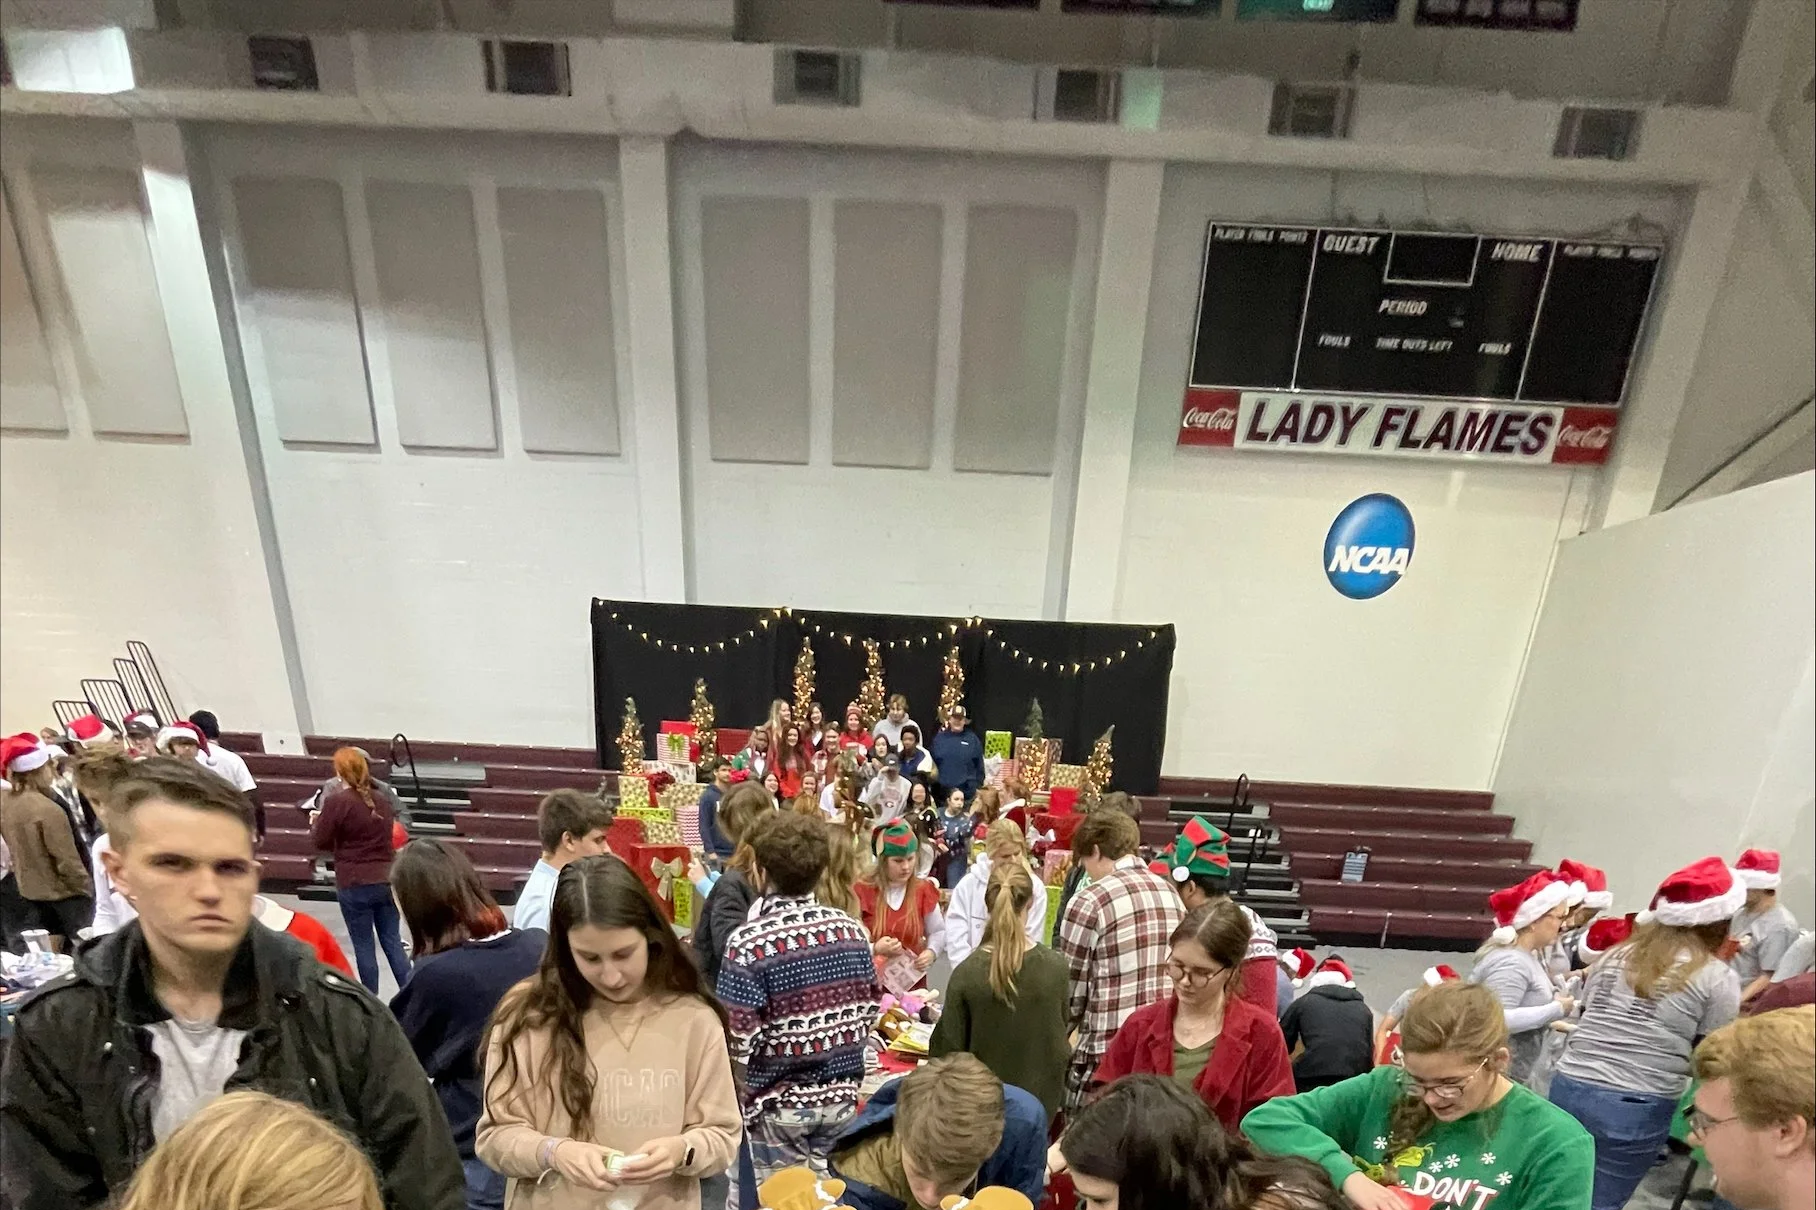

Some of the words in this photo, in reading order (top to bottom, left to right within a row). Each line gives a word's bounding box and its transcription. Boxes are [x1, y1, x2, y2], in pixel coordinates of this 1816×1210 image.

[1322, 234, 1380, 255] GUEST
[1491, 242, 1544, 263] HOME
[1378, 299, 1428, 316] PERIOD
[1318, 334, 1350, 347] FOULS
[1245, 399, 1373, 448] LADY
[1370, 403, 1556, 456] FLAMES
[1328, 545, 1410, 575] NCAA
